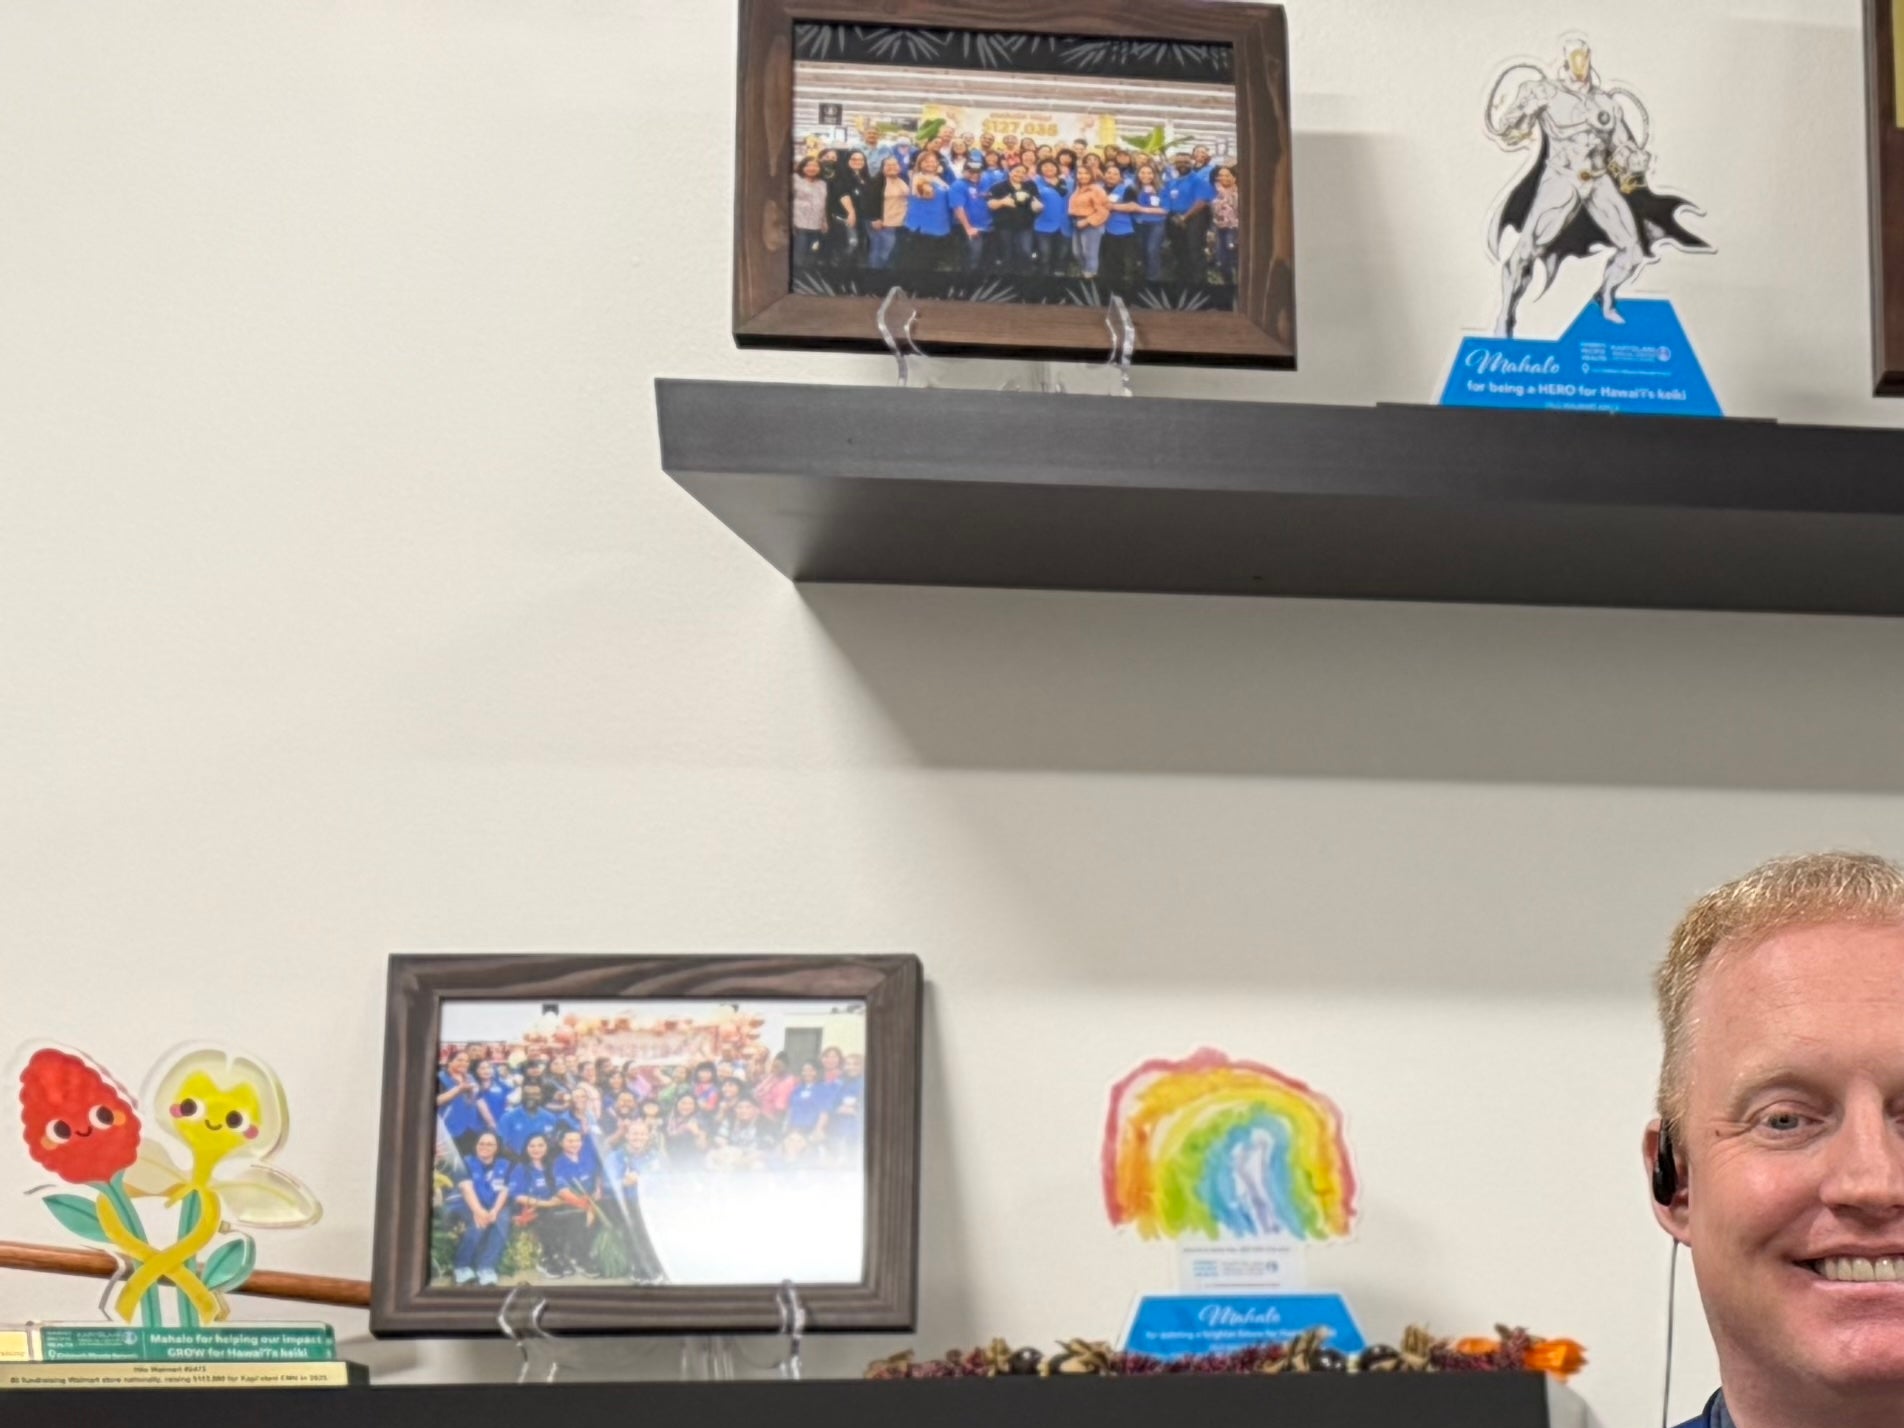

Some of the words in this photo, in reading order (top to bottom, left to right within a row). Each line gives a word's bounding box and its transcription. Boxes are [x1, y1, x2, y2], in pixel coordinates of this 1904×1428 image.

[1465, 348, 1560, 375] Mahalo
[1489, 381, 1524, 396] being
[1538, 384, 1576, 396] HERO
[1578, 385, 1596, 397] for
[1199, 1304, 1281, 1326] Mahalo
[150, 1333, 193, 1344] Mahalo
[195, 1333, 213, 1344] for
[215, 1333, 258, 1347] helping
[260, 1335, 280, 1344] our
[282, 1333, 322, 1346] impact
[167, 1347, 205, 1358] GROW
[207, 1347, 225, 1358] for
